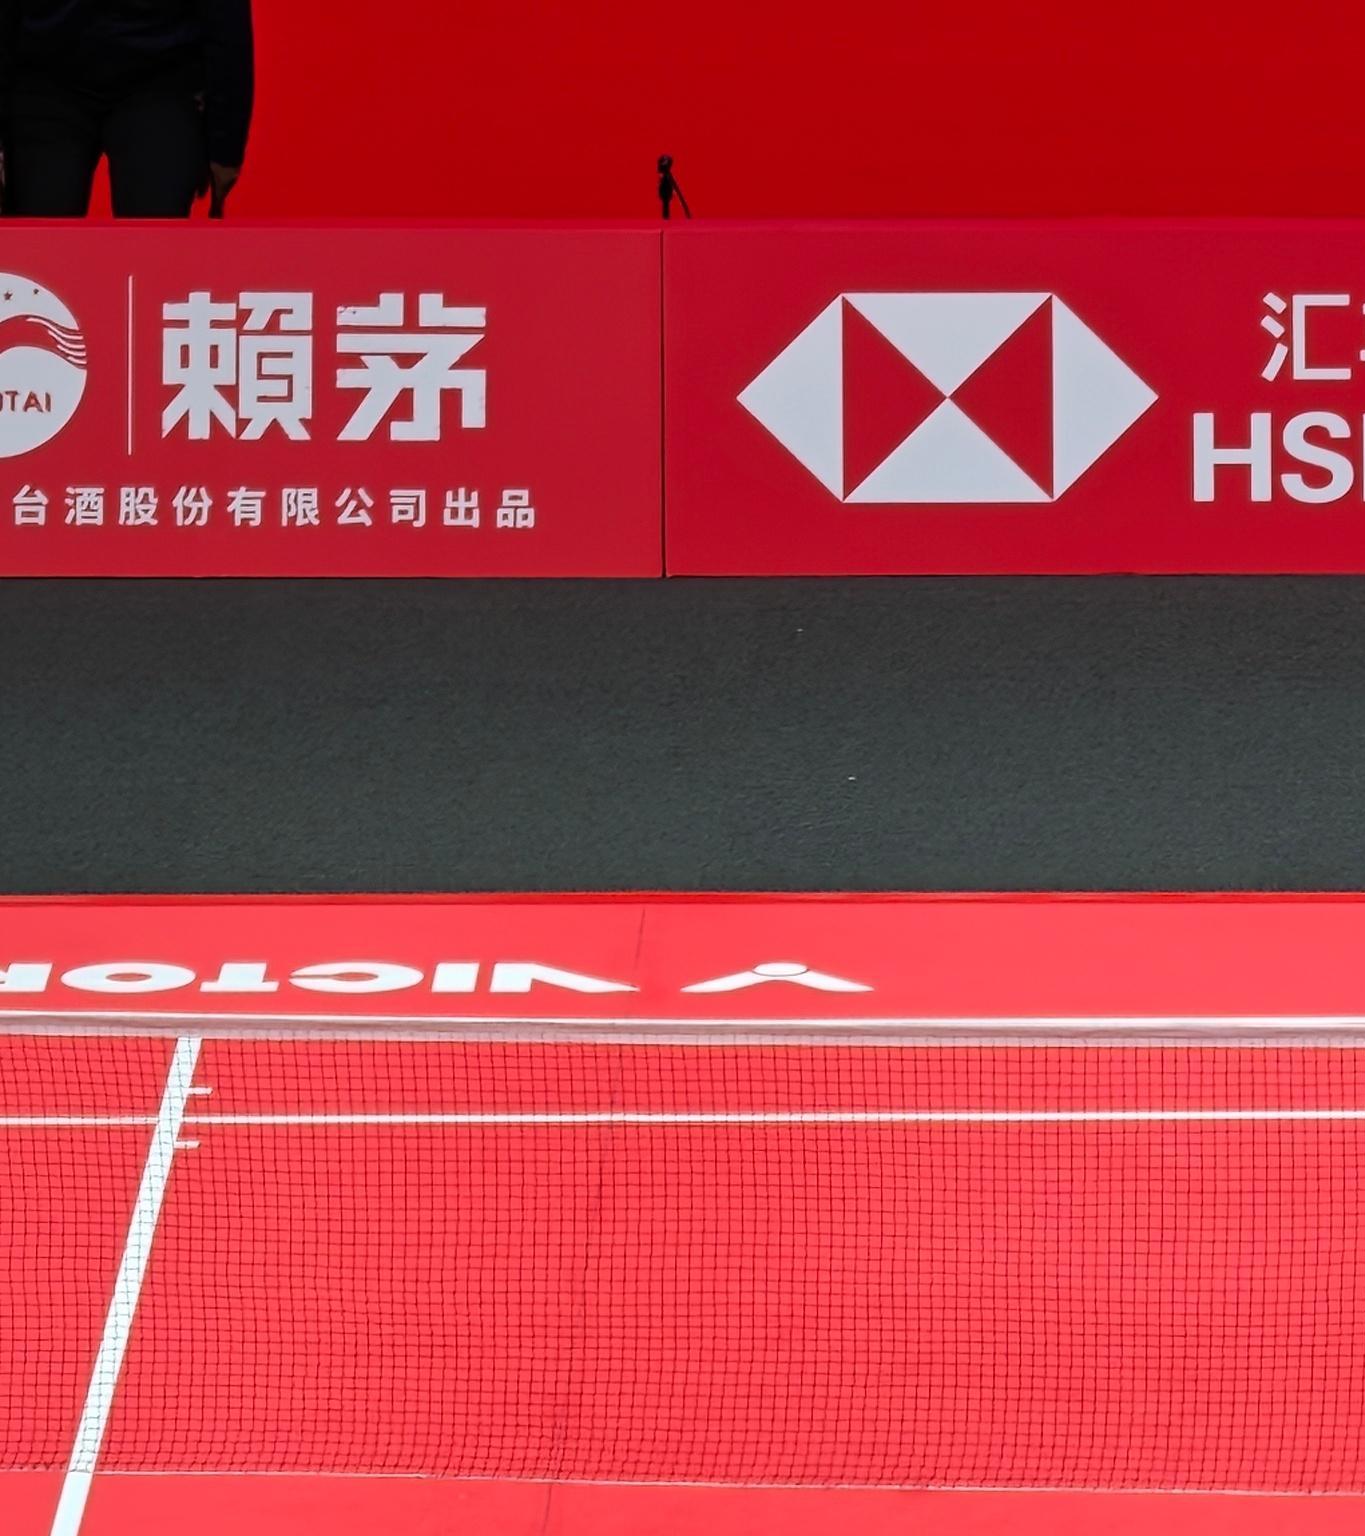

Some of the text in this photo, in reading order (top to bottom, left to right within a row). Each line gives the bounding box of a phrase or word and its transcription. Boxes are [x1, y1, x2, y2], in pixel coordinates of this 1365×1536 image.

[0, 390, 51, 413] TAI
[12, 485, 535, 529] 台酒股份有限公司出品
